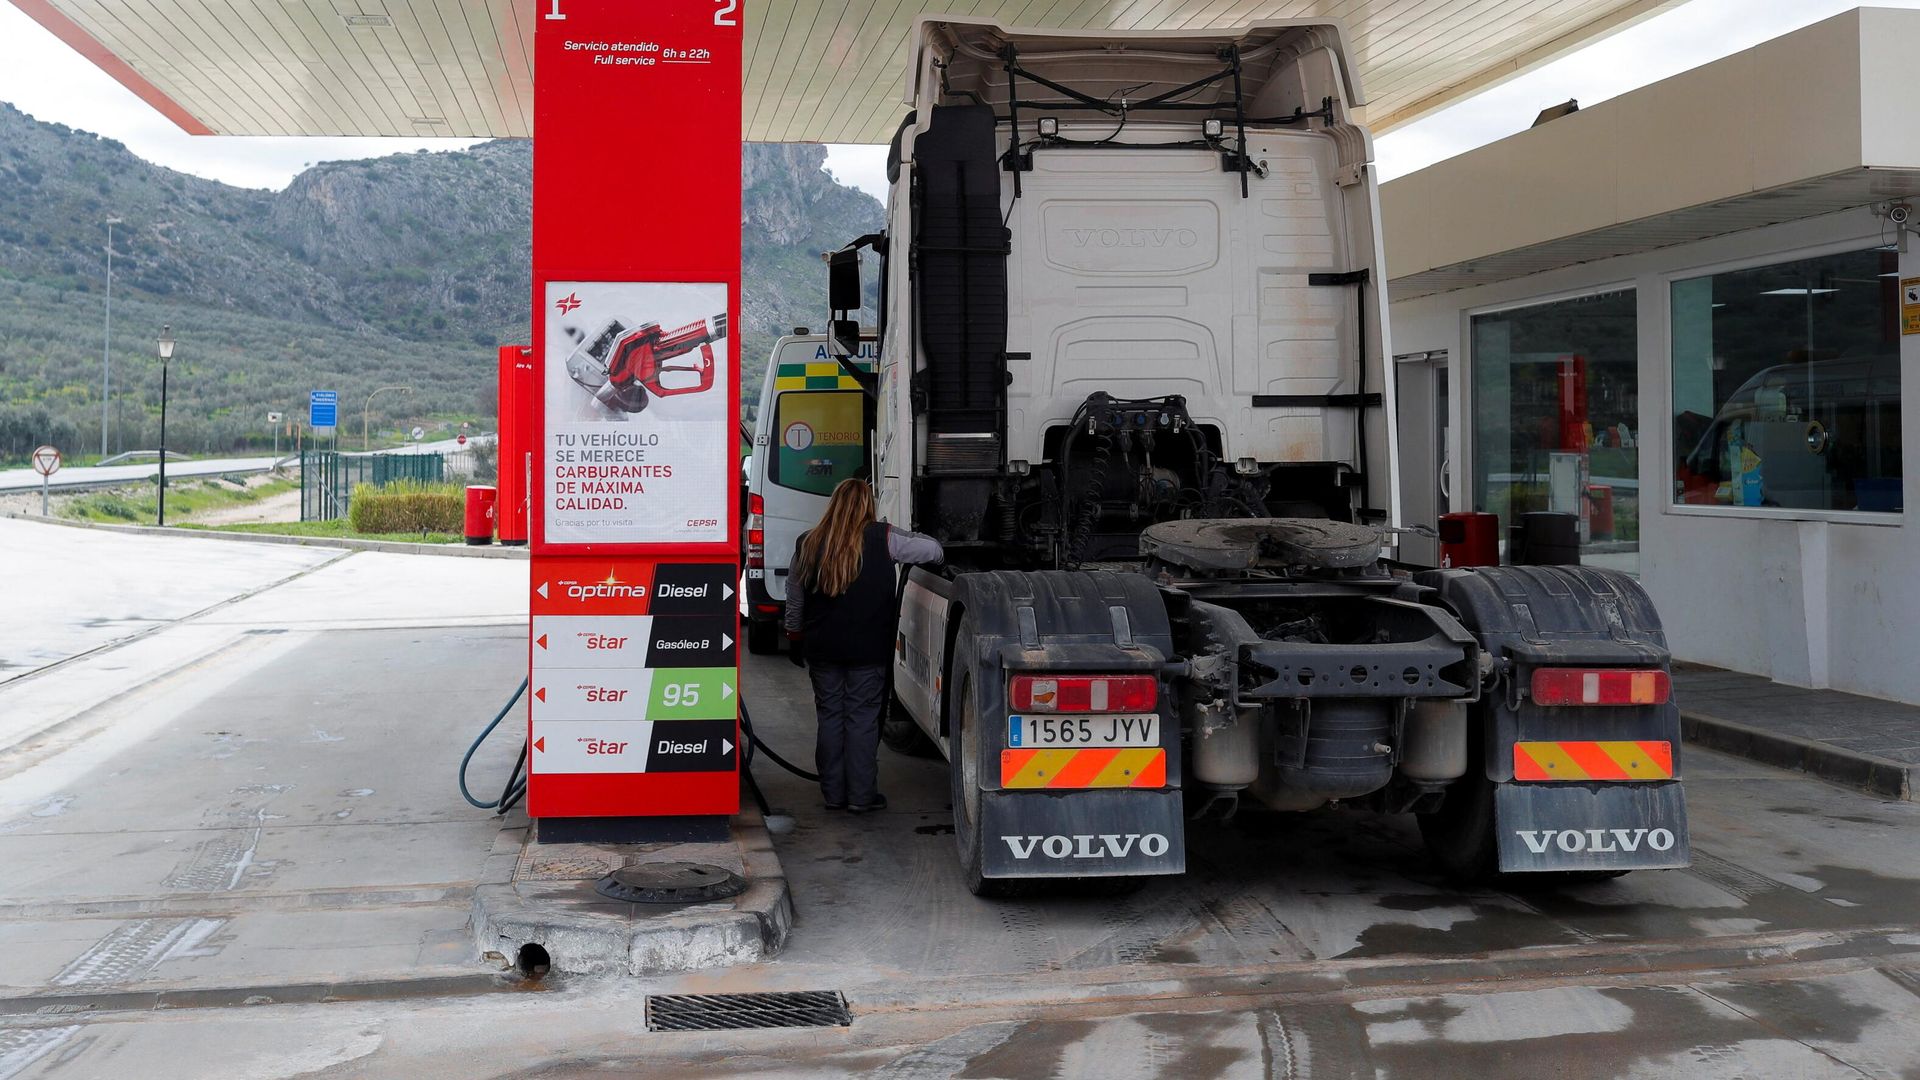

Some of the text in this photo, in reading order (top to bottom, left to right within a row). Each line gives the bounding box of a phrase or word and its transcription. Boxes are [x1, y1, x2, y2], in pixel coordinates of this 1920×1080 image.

[545, 0, 566, 20] 1
[714, 0, 737, 26] 2
[564, 40, 659, 52] Servicio atendido
[662, 48, 710, 59] 6h a 22h
[594, 54, 656, 66] Full service
[1062, 228, 1198, 248] VOLVO
[555, 431, 659, 446] TU VEHÍCULO
[816, 431, 860, 441] TENORIO
[555, 450, 645, 462] SE MERECE
[555, 465, 673, 478] CARBURANTES
[555, 479, 644, 494] DE MÁXIMA
[555, 497, 628, 510] CALIDAD.
[555, 518, 633, 529] Gracias por tu visita
[686, 519, 718, 527] CEPSA
[567, 583, 646, 602] optima
[657, 583, 708, 598] Diesel
[586, 634, 628, 649] star
[656, 639, 710, 650] Gasóleo B
[586, 687, 628, 702] star
[662, 683, 700, 707] 95
[1013, 734, 1018, 742] E
[1030, 718, 1152, 743] 1565 JYV
[586, 739, 628, 754] star
[657, 740, 708, 755] Diesel
[1001, 833, 1169, 859] VOLVO
[1516, 827, 1675, 853] VOLVO
